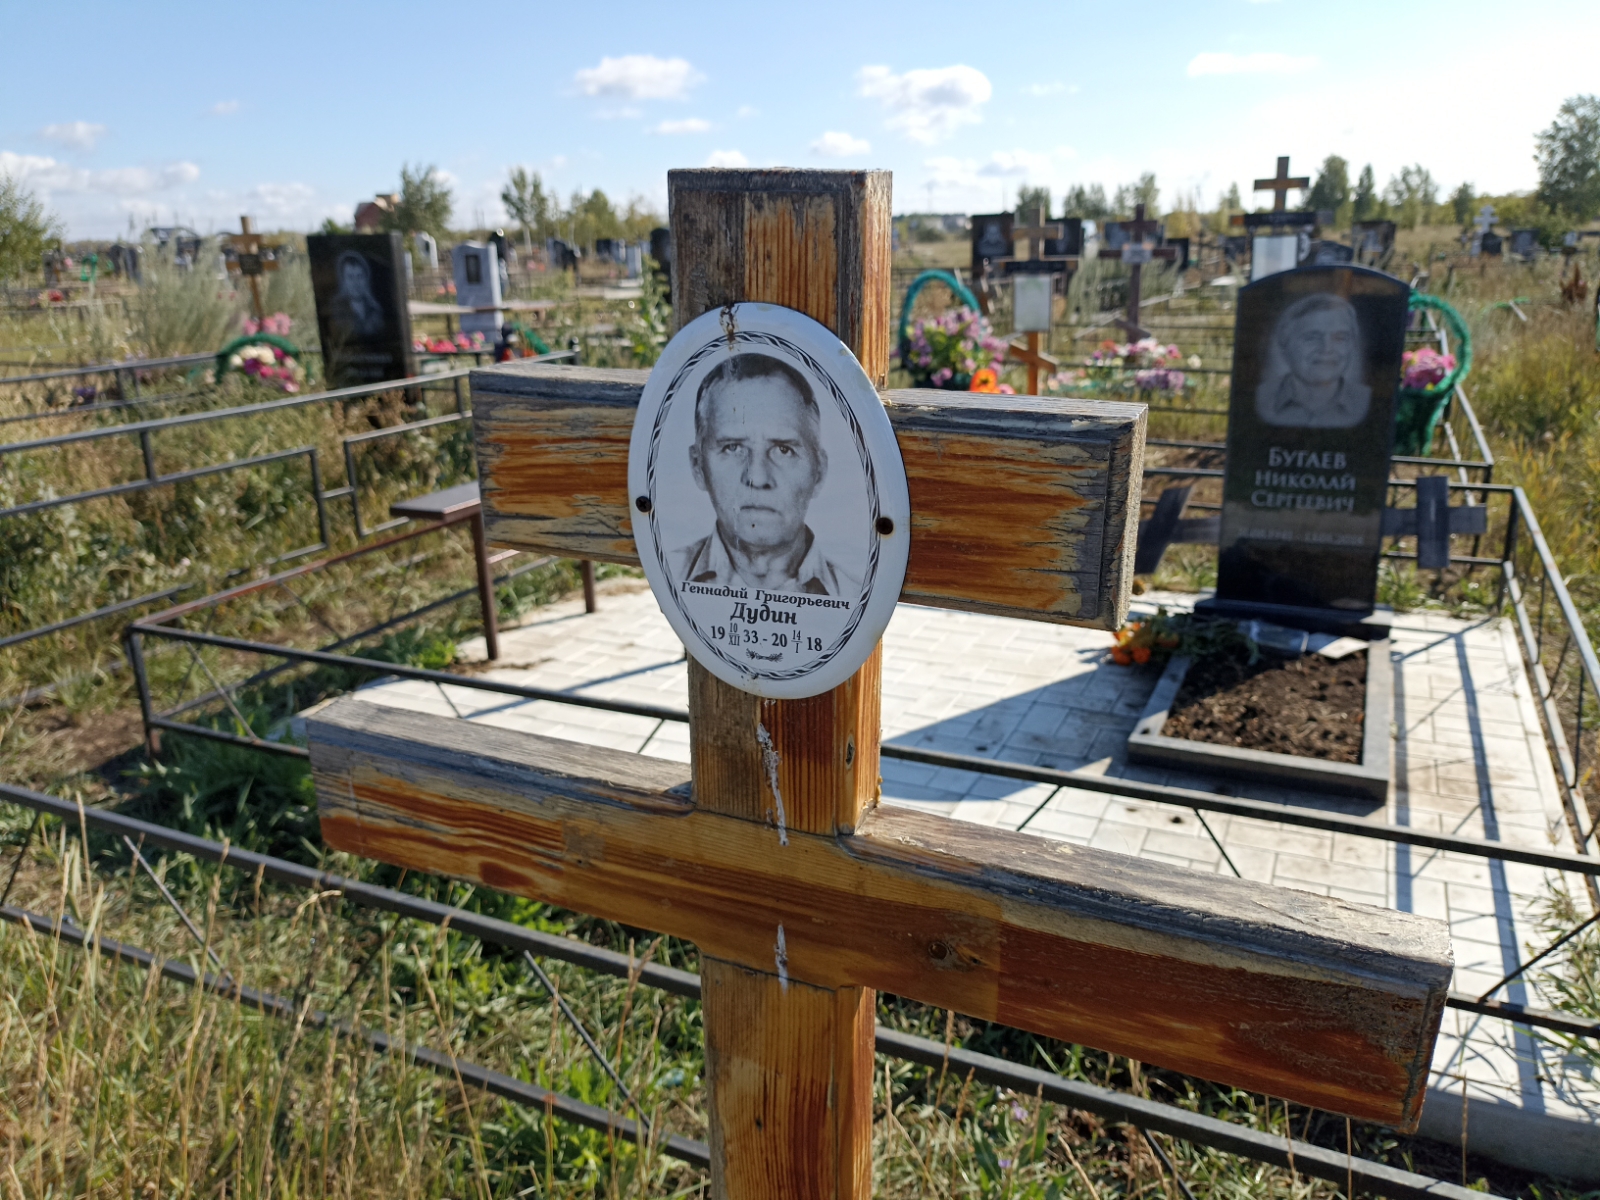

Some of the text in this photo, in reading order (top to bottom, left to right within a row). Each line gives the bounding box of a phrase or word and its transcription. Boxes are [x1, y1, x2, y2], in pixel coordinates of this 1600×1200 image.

[1267, 446, 1348, 470] БУГАЕВ
[1254, 469, 1357, 491] НИКОЛАЙ
[1250, 488, 1355, 512] СЕРГЕЕВИЧ
[681, 582, 850, 609] Геннадий Григорьевич
[730, 602, 797, 625] Дудин
[711, 626, 725, 639] 19
[729, 622, 738, 633] 10
[743, 629, 758, 644] 33
[771, 633, 787, 647] 20
[792, 629, 801, 640] 14
[807, 637, 823, 651] 18
